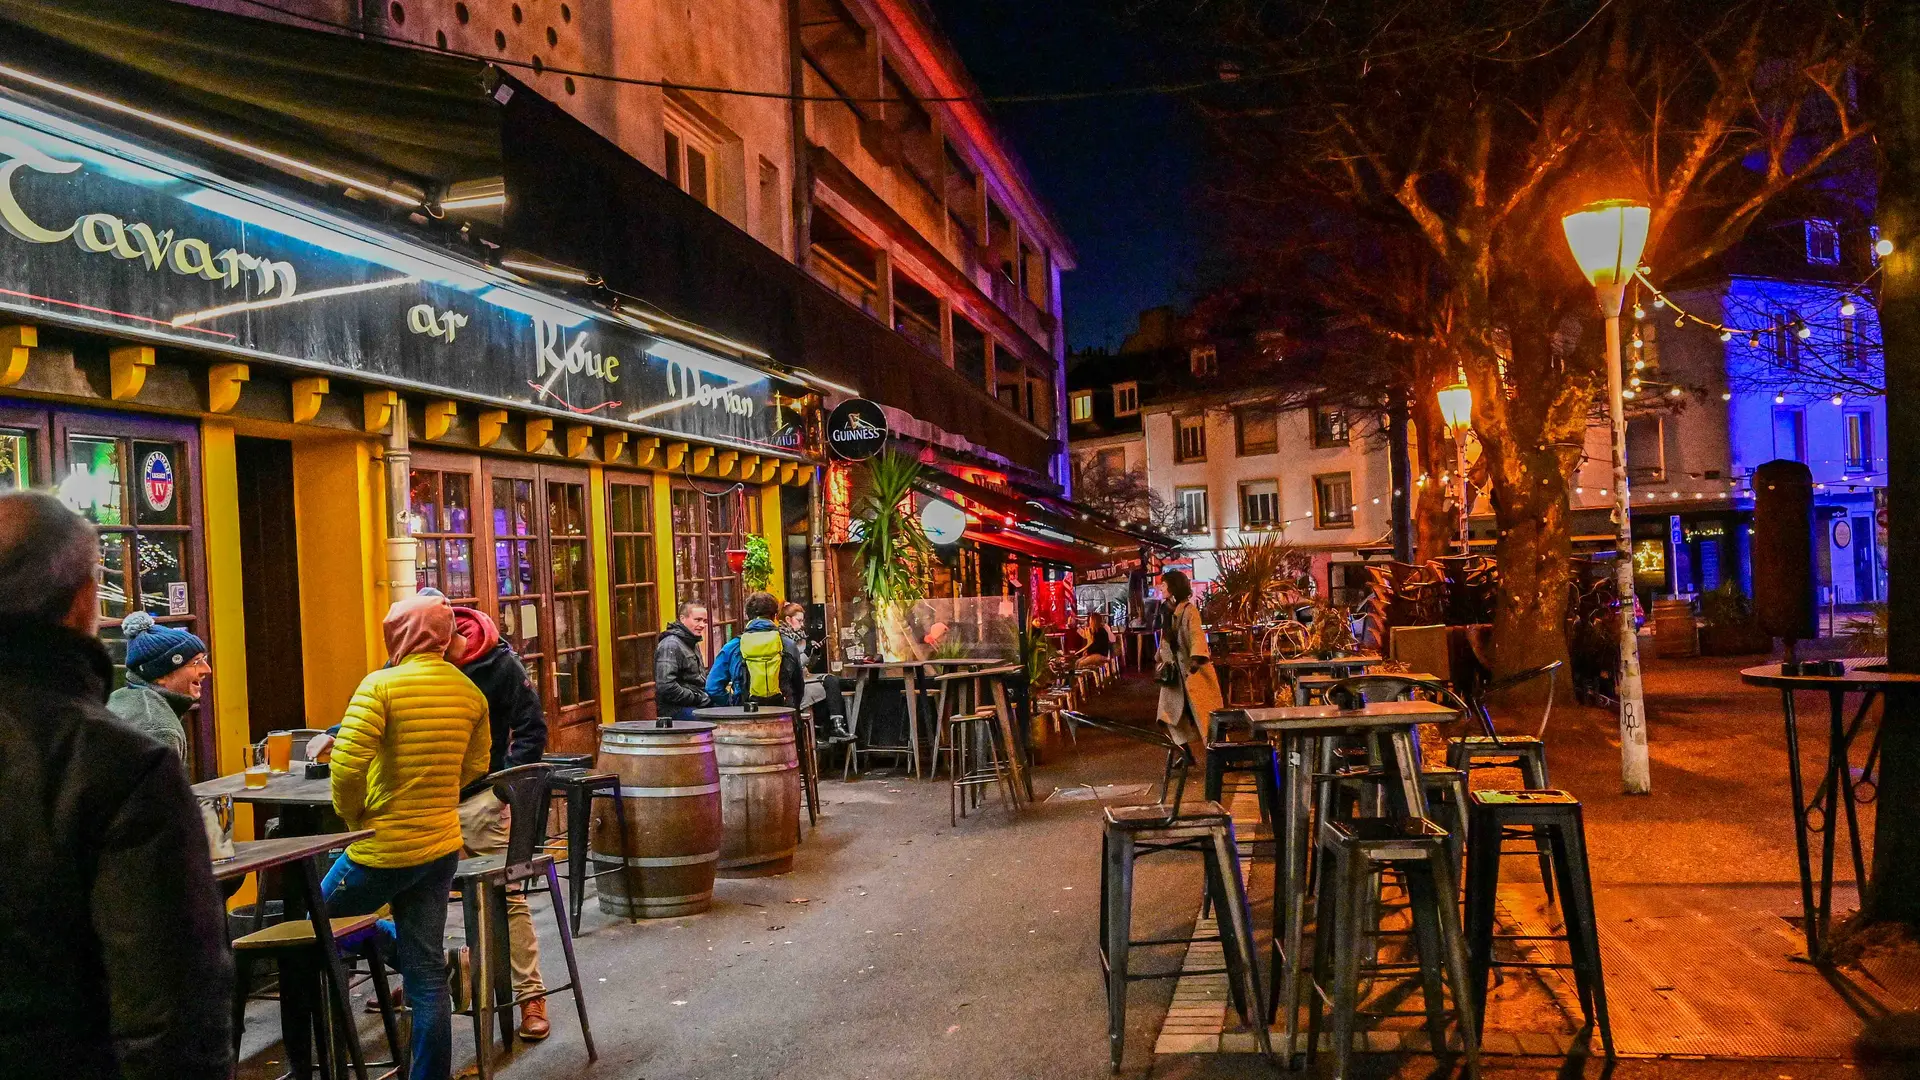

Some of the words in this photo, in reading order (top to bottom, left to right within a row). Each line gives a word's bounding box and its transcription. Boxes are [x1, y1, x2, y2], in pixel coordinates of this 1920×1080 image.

[0, 137, 297, 299] Tavarn
[407, 304, 468, 344] ar
[532, 317, 620, 383] Roue
[832, 427, 881, 442] GUINNESS
[155, 482, 166, 496] IV
